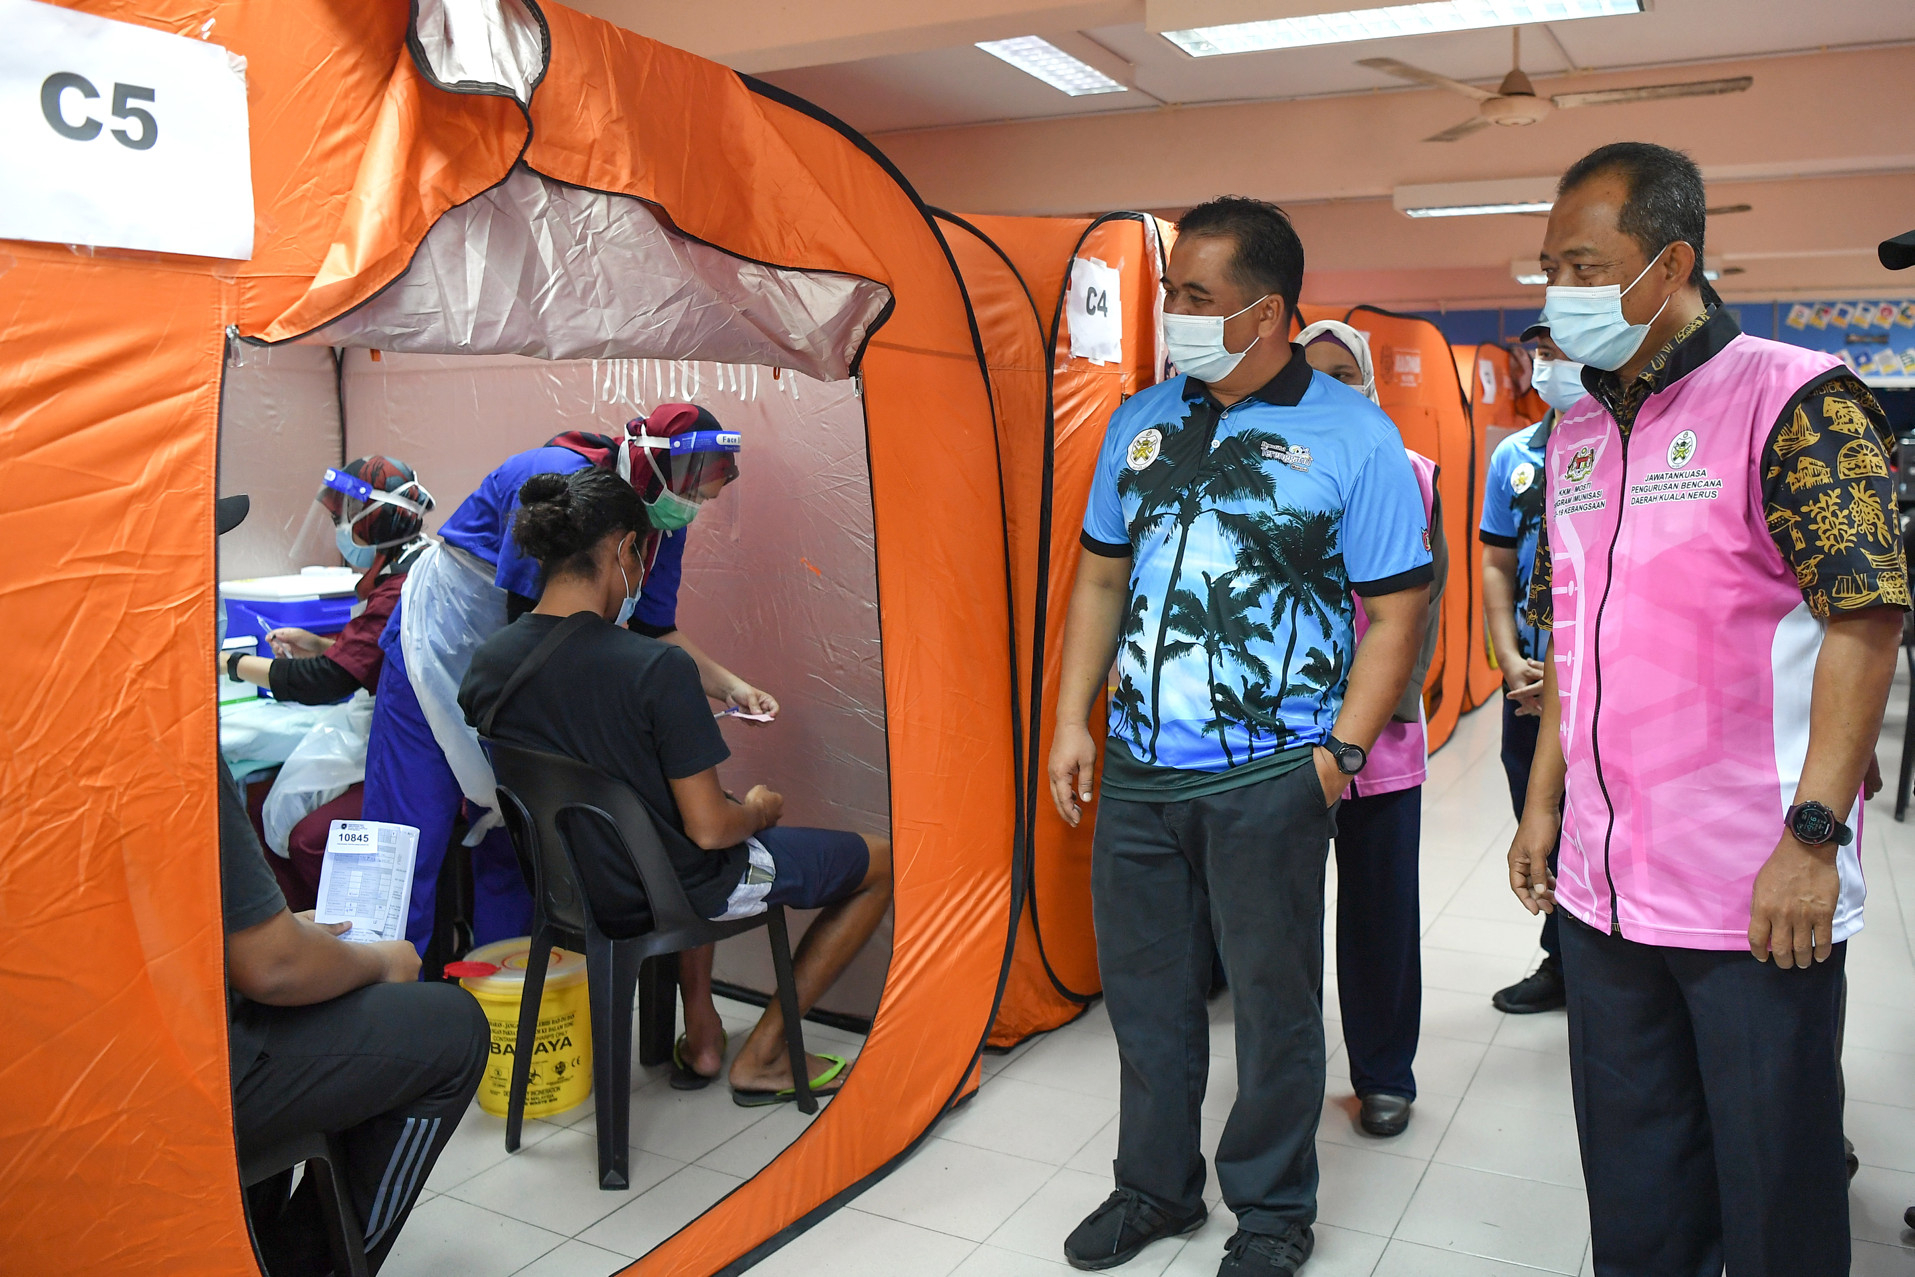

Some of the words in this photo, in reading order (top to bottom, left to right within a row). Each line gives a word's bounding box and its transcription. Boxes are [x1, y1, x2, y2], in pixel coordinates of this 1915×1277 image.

[40, 71, 159, 151] C5
[1086, 286, 1108, 318] C4
[722, 435, 737, 443] Face
[1645, 469, 1707, 482] JAWATANKUASA
[1631, 483, 1679, 494] PENGURUSAN
[1680, 480, 1722, 490] BENCANA
[1631, 495, 1658, 505] DAERAH
[1658, 492, 1686, 502] KUALA
[1687, 490, 1717, 499] NERUS
[1564, 500, 1606, 514] KEBANGSAAN
[338, 833, 369, 843] 10845
[490, 1036, 572, 1056] BAAYA
